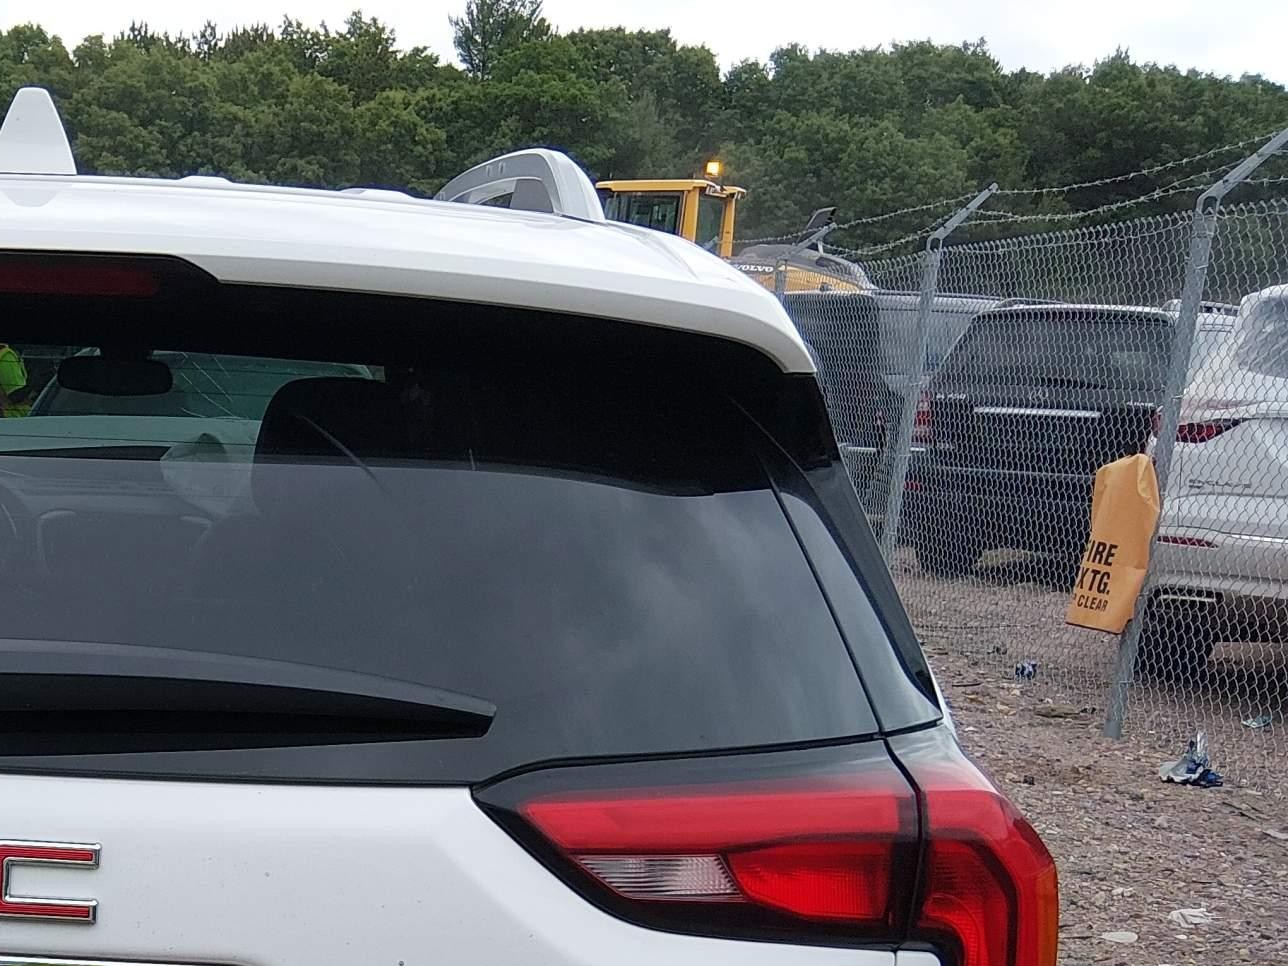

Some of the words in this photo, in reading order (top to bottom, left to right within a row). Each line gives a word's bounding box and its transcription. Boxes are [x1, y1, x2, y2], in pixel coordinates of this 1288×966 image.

[1086, 540, 1119, 567] IRE
[1076, 567, 1111, 595] XTG.
[1077, 594, 1109, 612] CLEAR
